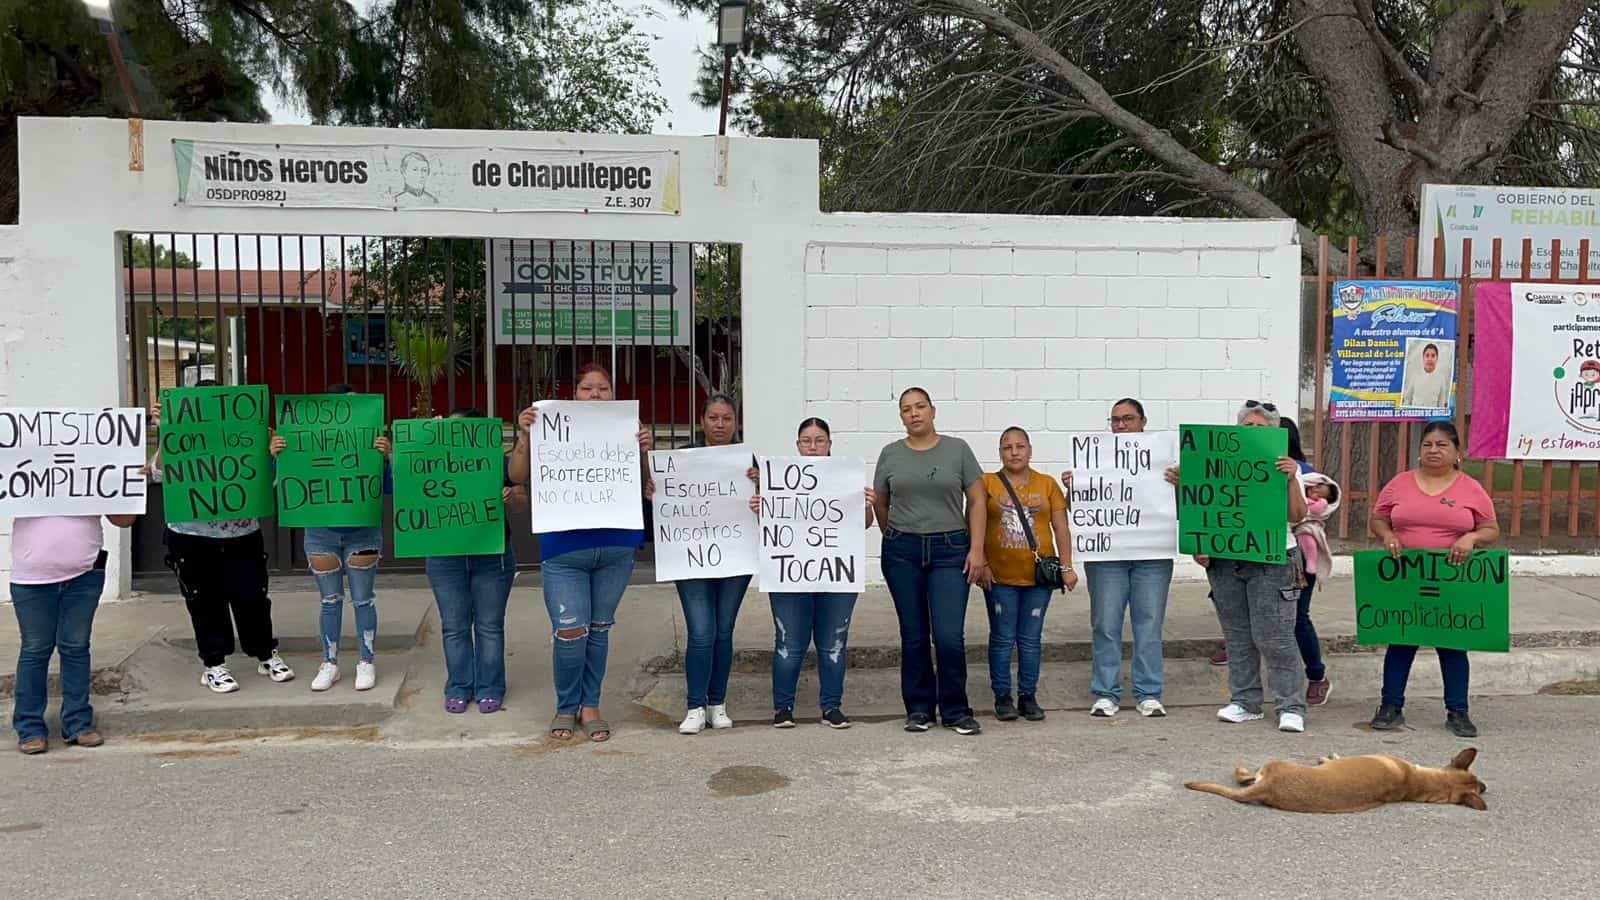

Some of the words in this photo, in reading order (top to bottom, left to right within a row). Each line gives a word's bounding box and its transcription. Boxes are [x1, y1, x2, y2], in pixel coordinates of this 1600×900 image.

[204, 151, 274, 182] Niños
[280, 158, 369, 184] Heroes
[472, 160, 501, 187] de
[508, 161, 651, 191] Chapultepec
[207, 188, 287, 201] 05DPR0982J
[605, 197, 627, 208] Z.E.
[629, 197, 652, 208] 307
[1571, 195, 1595, 206] DEL
[1536, 248, 1575, 257] Escela
[517, 263, 663, 281] CONSTRUYE
[1576, 314, 1586, 322] En
[1343, 339, 1366, 347] Dilan
[1354, 328, 1361, 336] A
[1361, 329, 1391, 337] nuestro
[1392, 328, 1420, 337] alumno
[1438, 328, 1444, 336] A
[1374, 350, 1384, 358] de
[280, 400, 350, 425] ACOSO
[0, 408, 141, 448] OMISIÓN
[394, 423, 417, 444] EL
[422, 421, 502, 448] SILENCIO
[542, 412, 571, 443] Mi
[1180, 429, 1196, 451] A
[400, 450, 491, 475] Tambien
[600, 443, 635, 464] debe
[652, 456, 676, 474] LA
[1073, 435, 1100, 470] Mi
[1115, 436, 1151, 476] hija
[664, 477, 737, 498] ESCUELA
[766, 460, 818, 491] LOS
[281, 474, 382, 511] DELITO
[423, 478, 457, 498] es
[538, 491, 558, 504] NO
[562, 488, 616, 504] CALLAR
[1120, 478, 1133, 502] la
[1182, 484, 1214, 506] NO
[1219, 484, 1248, 508] SE
[188, 482, 247, 519] NO
[761, 492, 844, 523] NIÑOS
[395, 498, 499, 532] CULPABLE
[1073, 505, 1141, 528] escuela
[763, 524, 794, 548] NO
[806, 526, 839, 548] SE
[687, 543, 722, 568] NO
[1378, 551, 1505, 584] OMISIÓN
[771, 555, 855, 583] TOCAN
[1357, 602, 1485, 637] Complicidad
